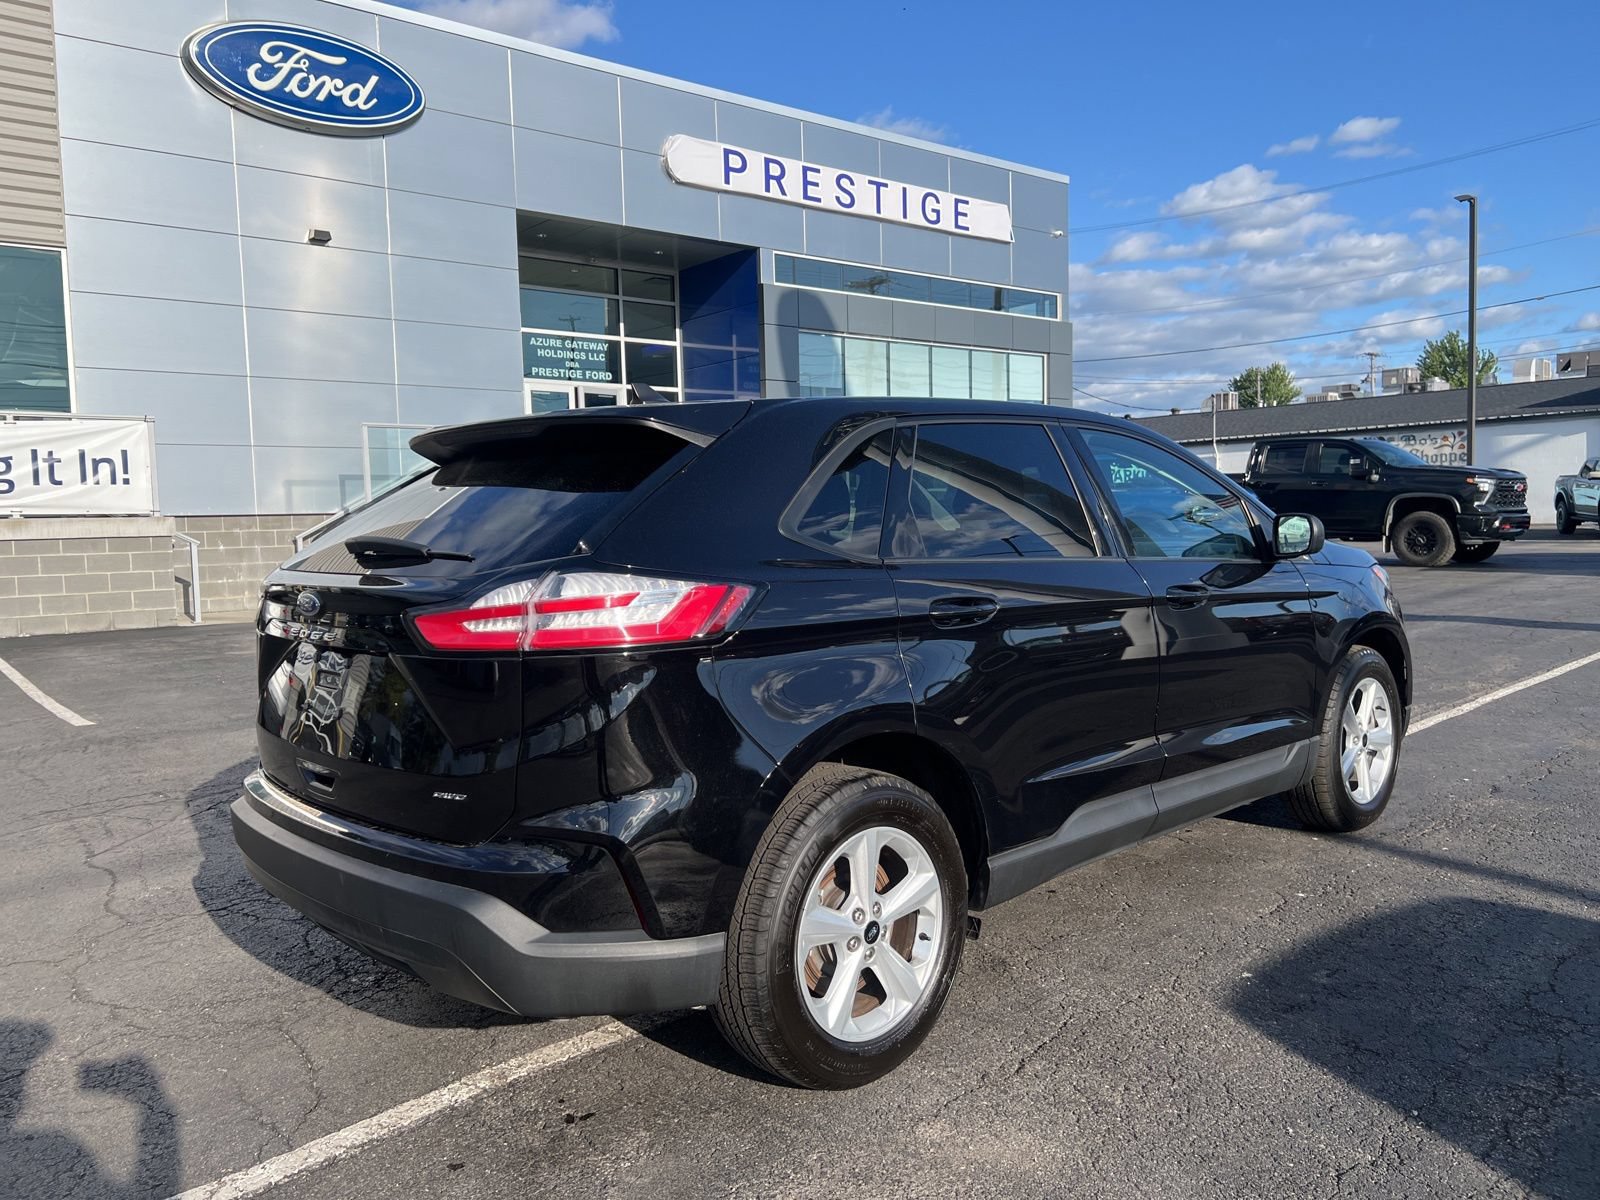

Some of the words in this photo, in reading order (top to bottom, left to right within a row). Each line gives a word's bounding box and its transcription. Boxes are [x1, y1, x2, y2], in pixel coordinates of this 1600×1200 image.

[247, 41, 379, 110] Ford
[722, 147, 971, 232] PRESTIGE
[530, 337, 562, 347] AZURE
[564, 340, 609, 351] GATEWAY
[537, 348, 586, 360] HOLDINGS
[588, 352, 606, 361] LLC
[531, 367, 583, 378] PRESTIGE
[585, 370, 613, 381] FORD
[30, 448, 63, 486] It
[78, 449, 130, 485] In!
